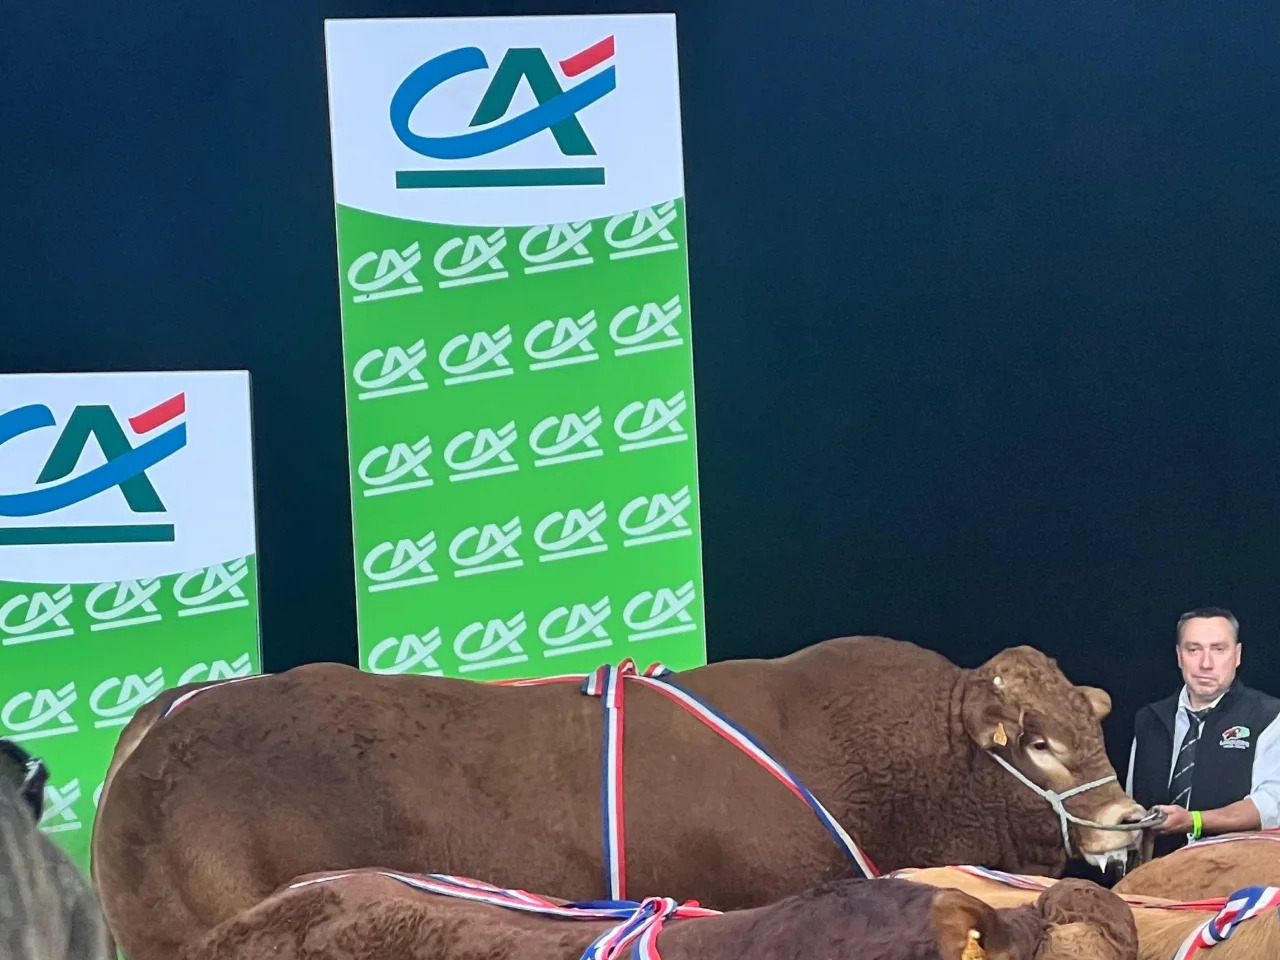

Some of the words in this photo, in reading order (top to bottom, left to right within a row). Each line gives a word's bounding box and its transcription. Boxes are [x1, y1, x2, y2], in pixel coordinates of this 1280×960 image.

[390, 35, 616, 159] CA
[347, 242, 421, 291] CA
[434, 228, 507, 278] CA
[519, 222, 593, 263] CA
[604, 200, 677, 249] CA
[353, 339, 427, 389] CA
[439, 325, 512, 374] CA
[524, 310, 597, 359] CA
[609, 295, 683, 345] CA
[358, 435, 433, 485] CA
[444, 421, 519, 470] CA
[529, 406, 602, 456] CA
[614, 390, 688, 440] CA
[363, 531, 439, 581] CA
[449, 516, 524, 566] CA
[534, 501, 608, 551] CA
[618, 485, 692, 535] CA
[0, 584, 73, 634] CA
[85, 579, 161, 620] CA
[173, 557, 249, 606] CA
[367, 627, 442, 674] CA
[454, 611, 528, 661] CA
[538, 596, 613, 645] CA
[623, 581, 697, 630] CA
[1, 681, 77, 731] CA
